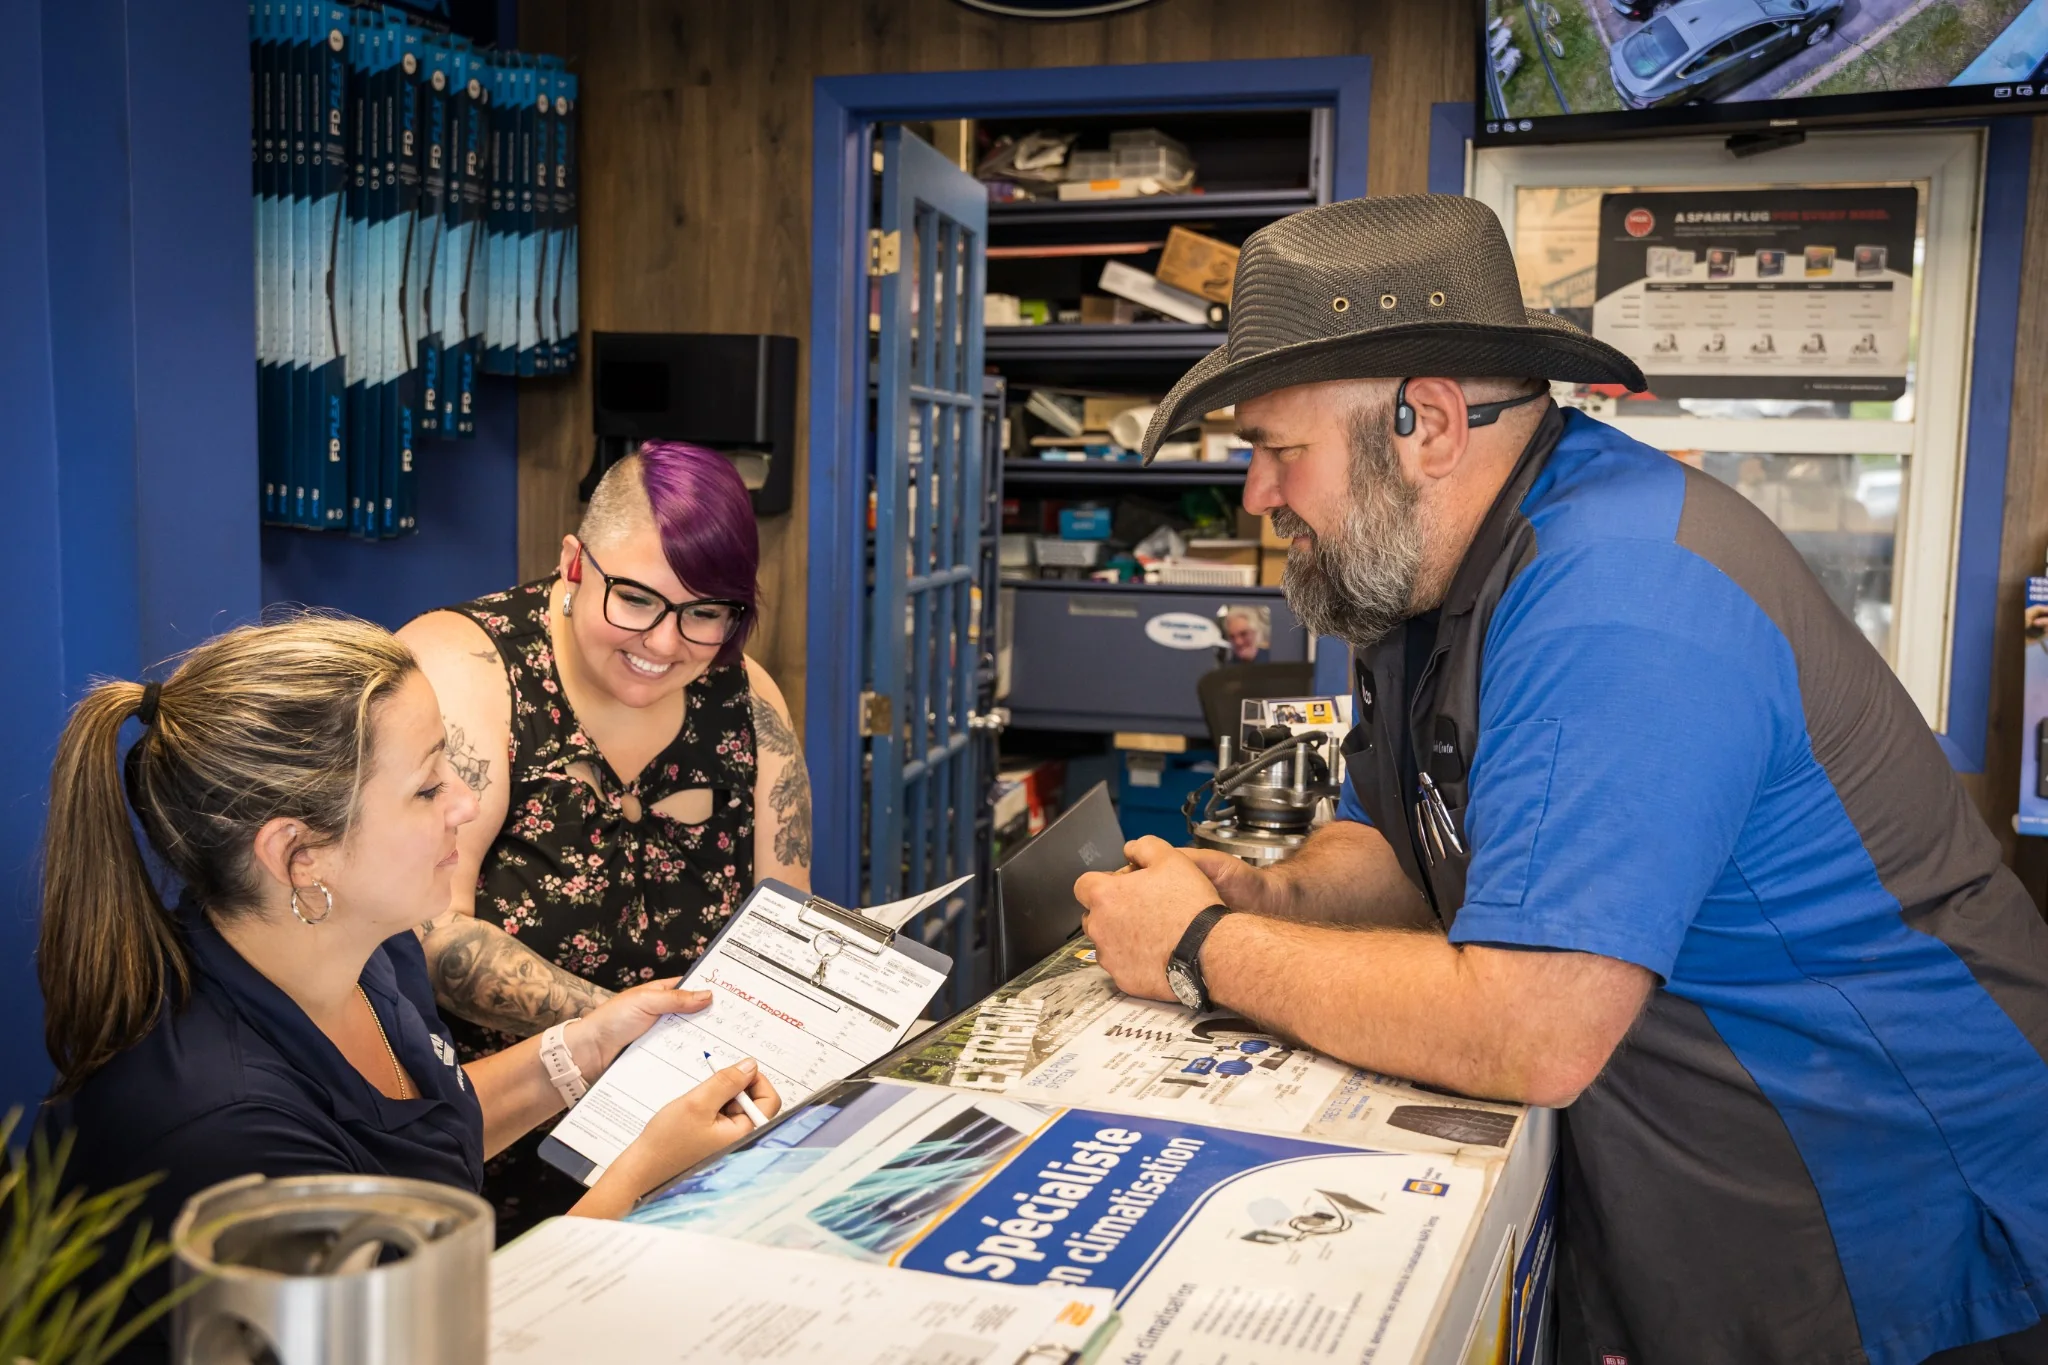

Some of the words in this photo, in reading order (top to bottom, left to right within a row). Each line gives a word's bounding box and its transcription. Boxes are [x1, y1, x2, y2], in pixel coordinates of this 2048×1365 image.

[1675, 212, 1685, 223] A
[1687, 212, 1731, 223] SPARK
[1734, 211, 1770, 222] PLUG
[943, 1128, 1142, 1280] Spécialiste
[1063, 1137, 1206, 1264] climatisation
[1135, 1284, 1198, 1351] climatisation
